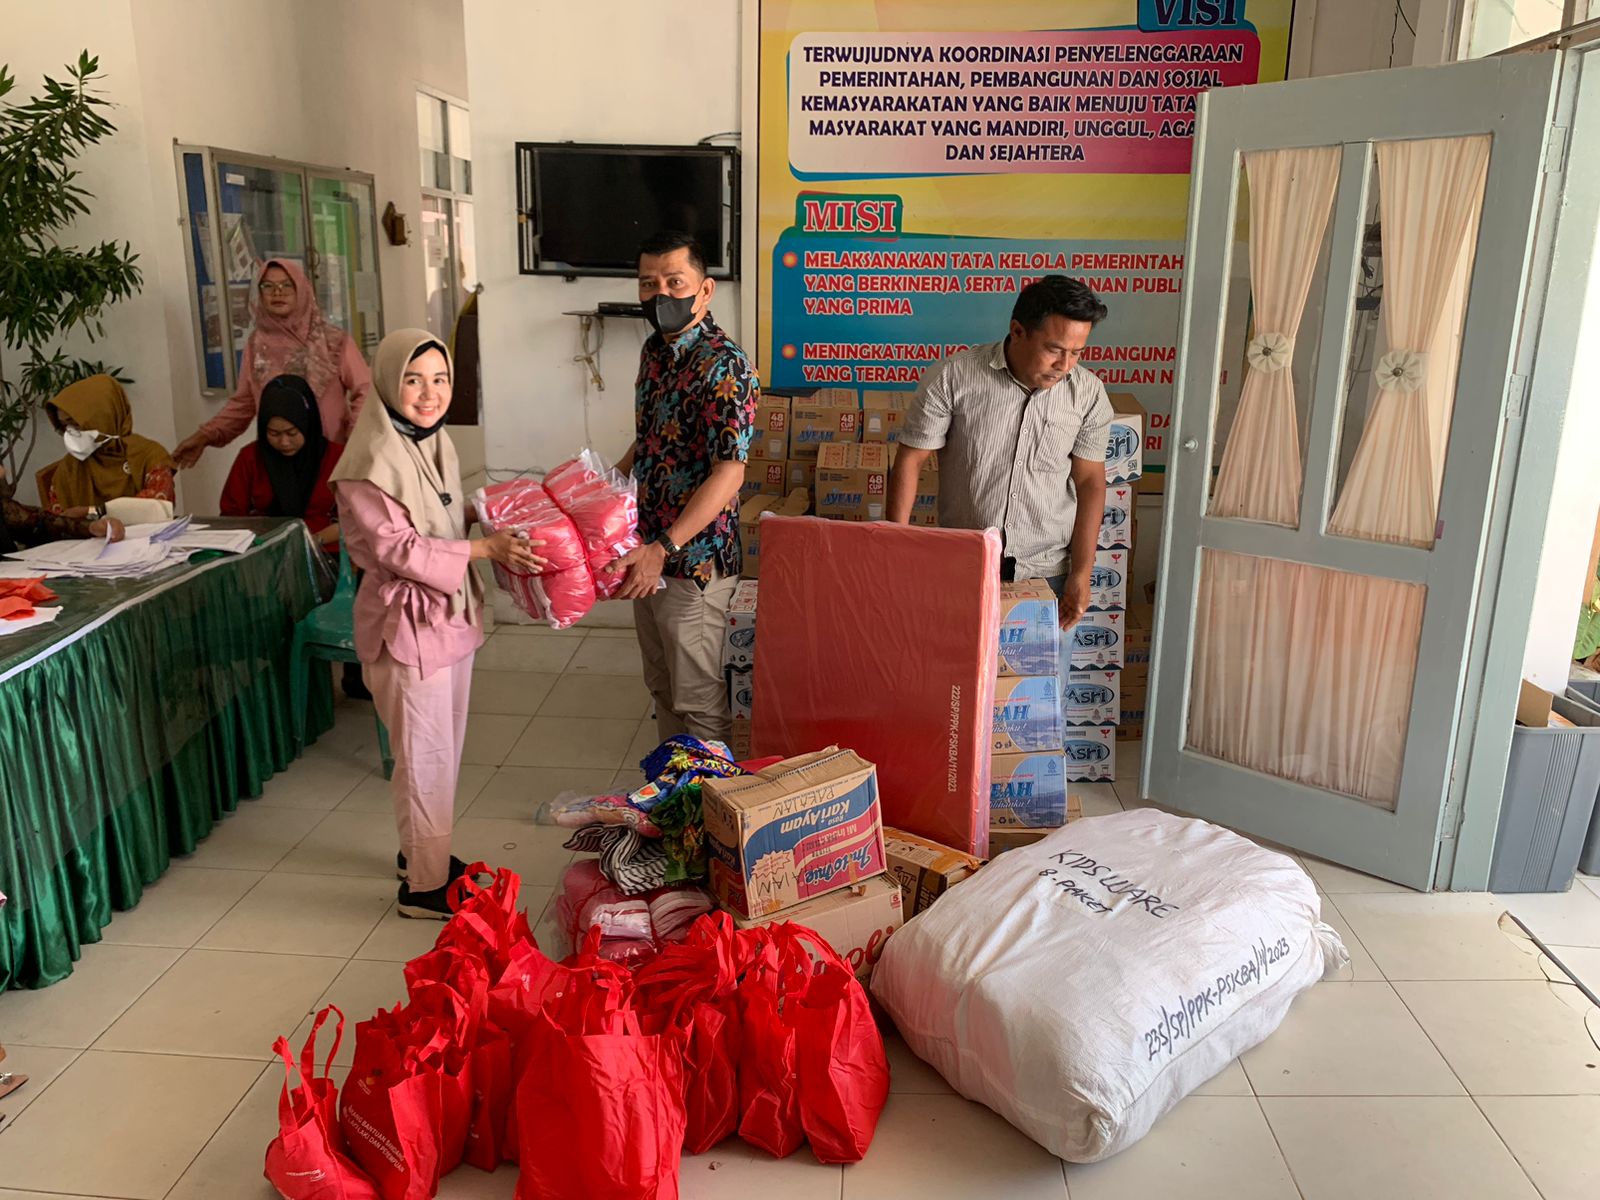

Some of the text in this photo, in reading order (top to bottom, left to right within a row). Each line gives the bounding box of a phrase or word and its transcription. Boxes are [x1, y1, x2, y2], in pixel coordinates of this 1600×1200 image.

[1154, 0, 1238, 26] VISI
[803, 43, 1244, 64] TERWUJUDNYA KOORDINASI PENYELENGGARAAN
[819, 70, 1223, 91] PEMERINTAHAN, PEMBANGUNAN DAN SOSIAL
[801, 95, 1197, 114] KEMASYARAKATAN YANG BAIK MENUJU TATA
[809, 120, 927, 137] MASYARAKAT
[931, 120, 982, 138] YANG
[986, 120, 1070, 138] MANDIRI,
[1074, 120, 1155, 139] UNGGUL,
[945, 145, 1086, 163] DAN SEJAHTERA
[803, 200, 897, 232] MISI
[804, 251, 1185, 271] MELAKSANAKAN TATA KELOLA PEMERINTAH
[804, 274, 854, 292] YANG
[857, 275, 961, 294] BERKINERJA
[965, 275, 1016, 293] SERTA
[803, 297, 914, 316] YANG PRIMA
[802, 343, 942, 361] MENINGKATKAN
[802, 365, 852, 382] YANG
[855, 366, 926, 382] TERARA
[770, 413, 785, 422] 48
[840, 414, 855, 423] 48
[869, 475, 883, 484] 48
[1066, 685, 1108, 706] Asri
[780, 799, 851, 836] Kari Ayam
[845, 823, 858, 835] Mi
